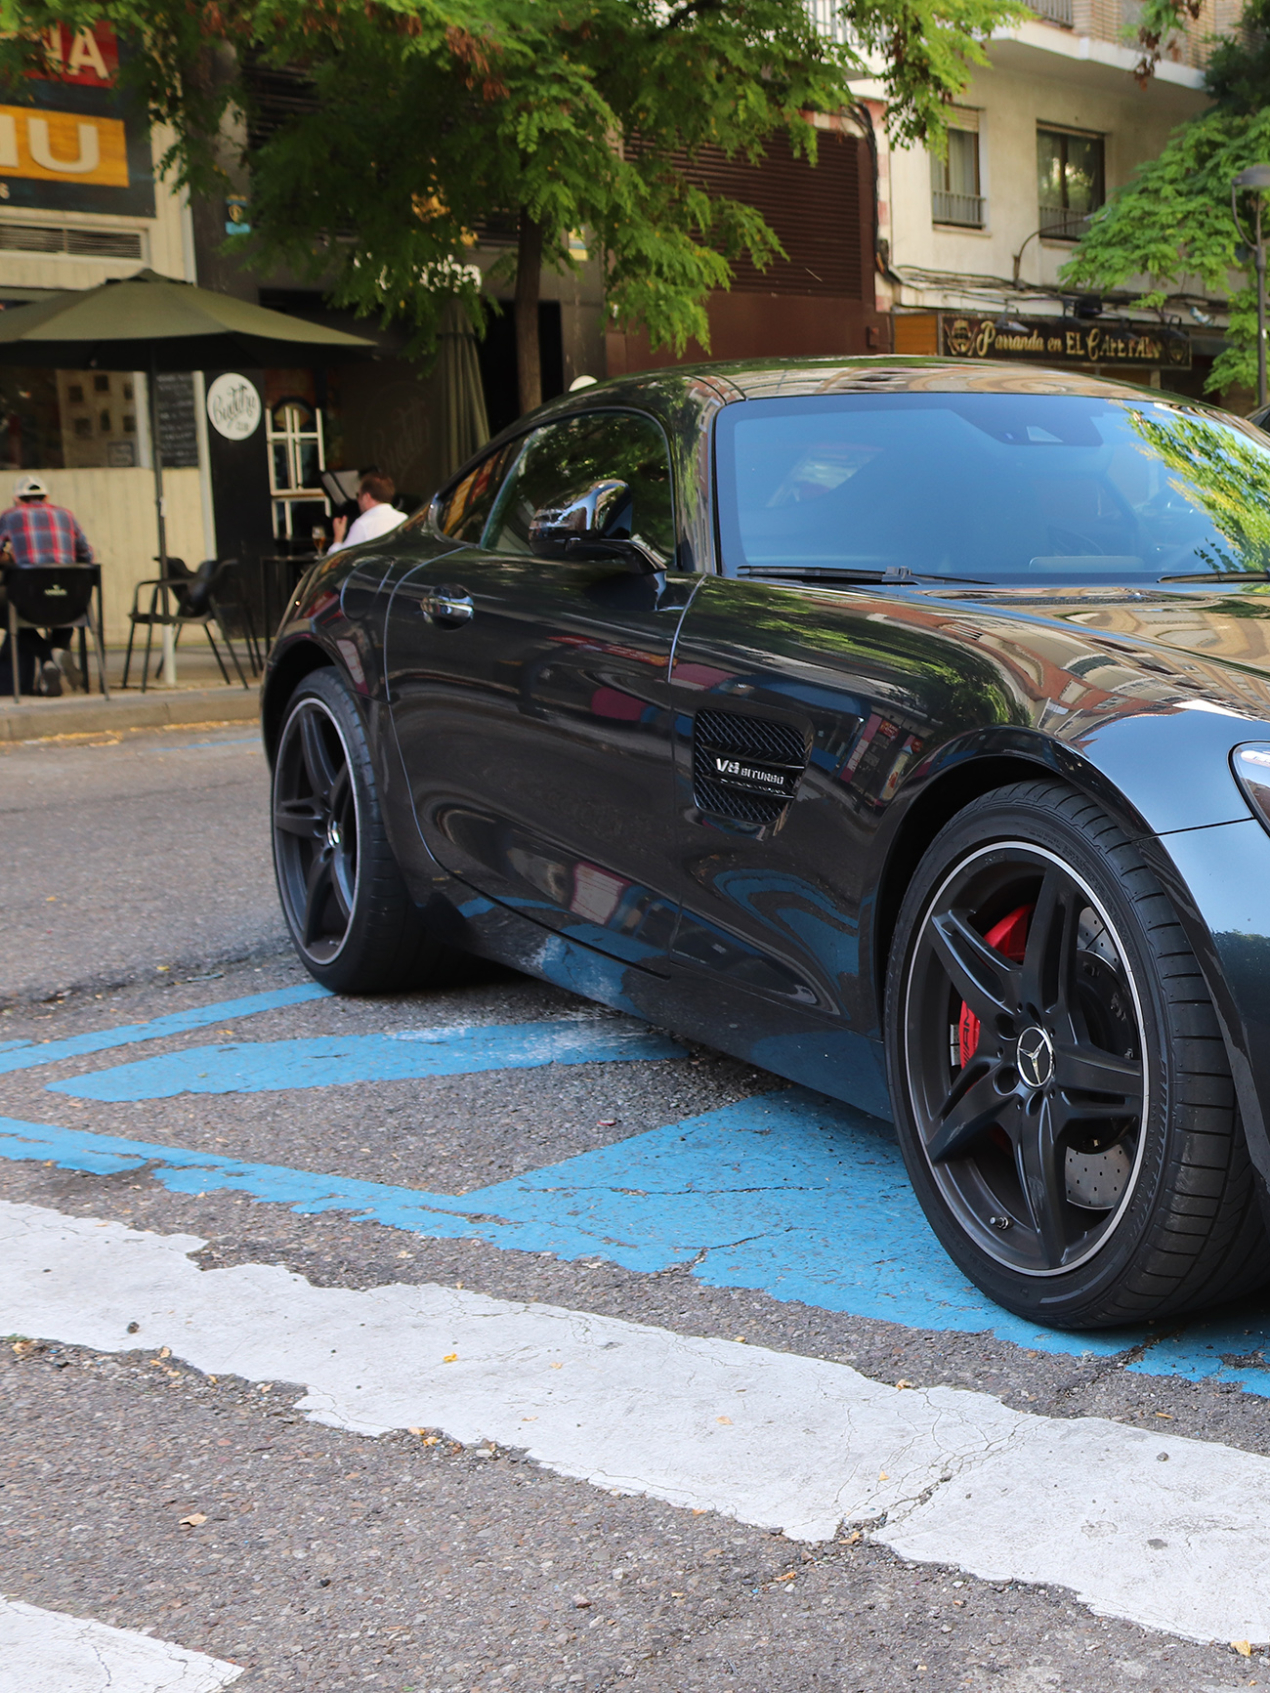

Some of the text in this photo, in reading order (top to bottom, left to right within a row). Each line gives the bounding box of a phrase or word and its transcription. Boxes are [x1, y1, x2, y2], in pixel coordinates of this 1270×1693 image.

[1047, 337, 1063, 353] en
[1065, 331, 1085, 355] EL
[715, 757, 785, 786] V8 BITURBO
